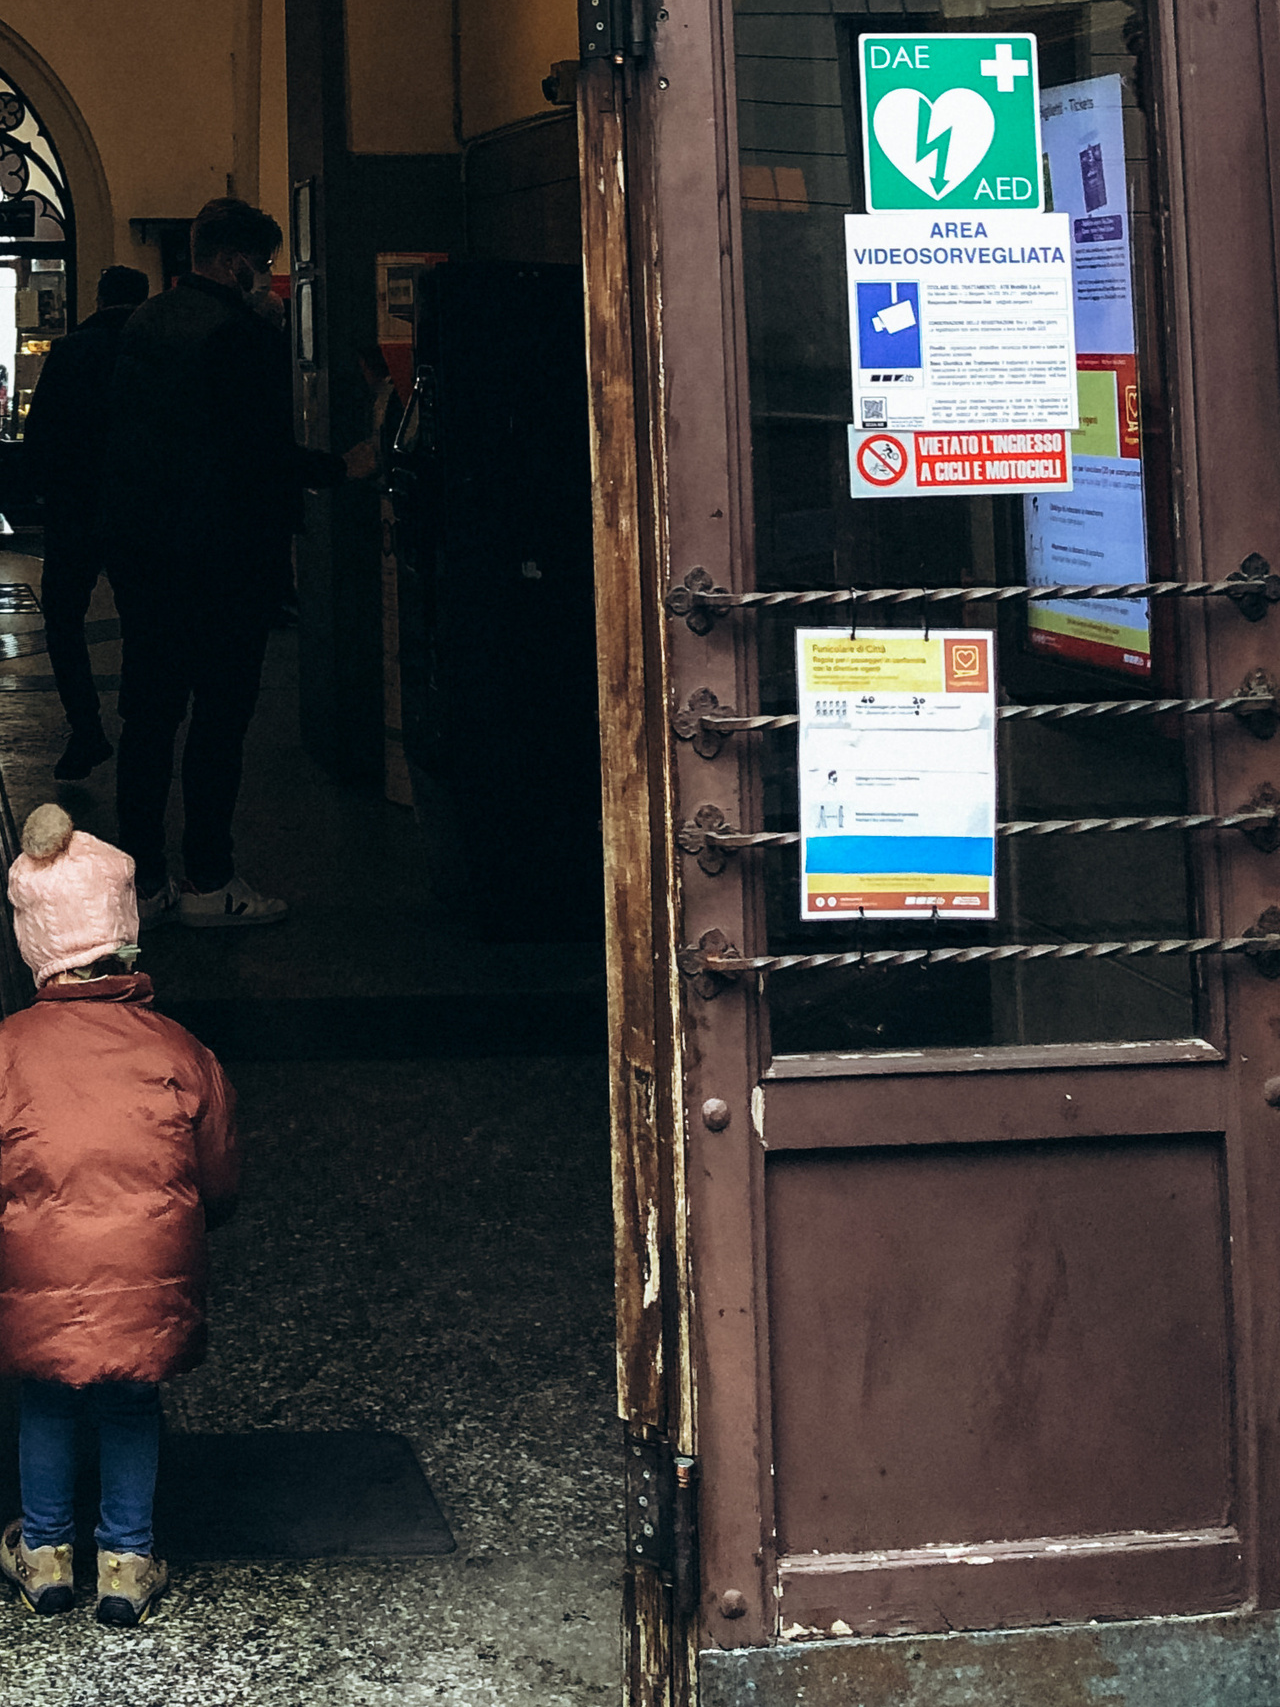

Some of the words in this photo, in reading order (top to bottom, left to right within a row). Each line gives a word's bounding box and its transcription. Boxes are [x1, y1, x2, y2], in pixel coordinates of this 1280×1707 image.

[870, 45, 931, 70] DAE
[973, 176, 1032, 202] AED
[929, 221, 988, 239] AREA
[853, 247, 1066, 265] VIDEOSORVEGLIATA
[918, 434, 979, 456] VIETATO
[983, 432, 1063, 455] L'INGRESSO
[920, 463, 933, 482] A
[935, 461, 972, 481] CICLI
[974, 460, 983, 480] E
[986, 458, 1062, 480] MOTOCICLI
